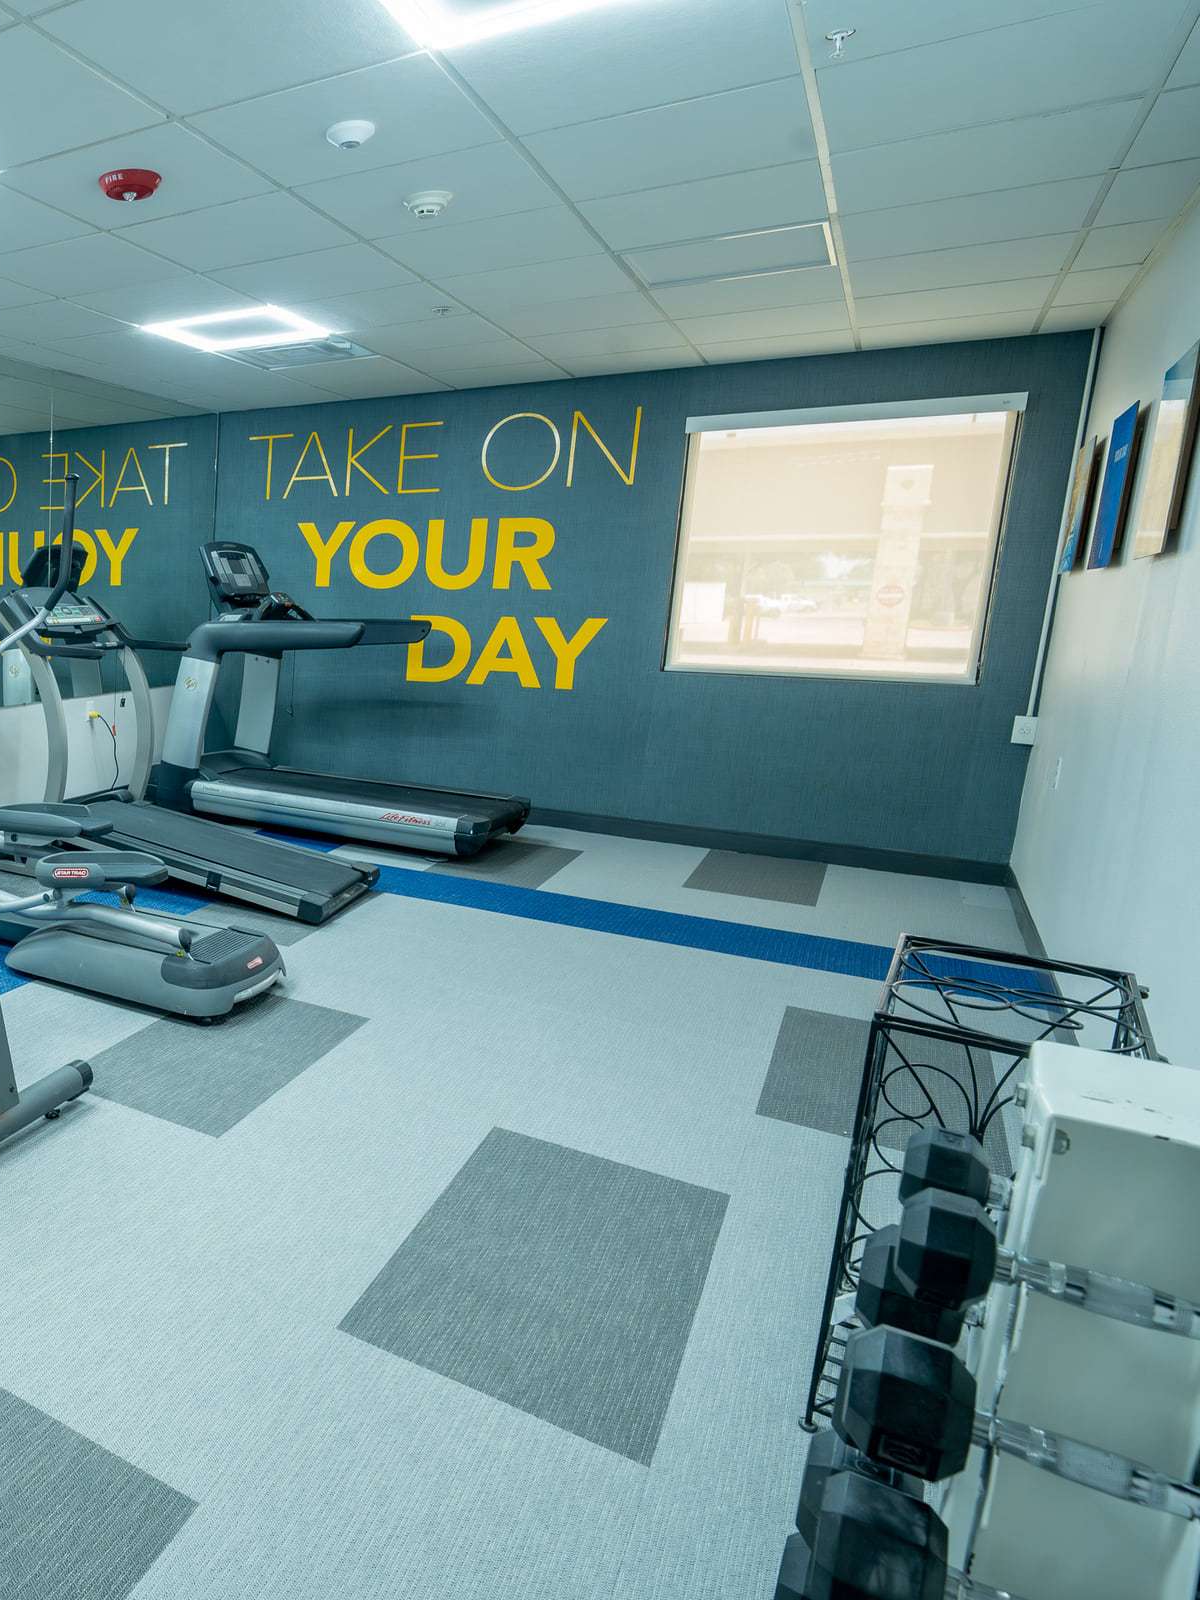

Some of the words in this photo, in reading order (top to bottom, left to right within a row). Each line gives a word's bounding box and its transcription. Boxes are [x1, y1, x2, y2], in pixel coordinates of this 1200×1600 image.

[104, 173, 124, 184] FIRE
[249, 421, 444, 500] TAKE
[481, 405, 643, 492] ON
[297, 517, 556, 591] YOUR
[405, 614, 609, 690] DAY
